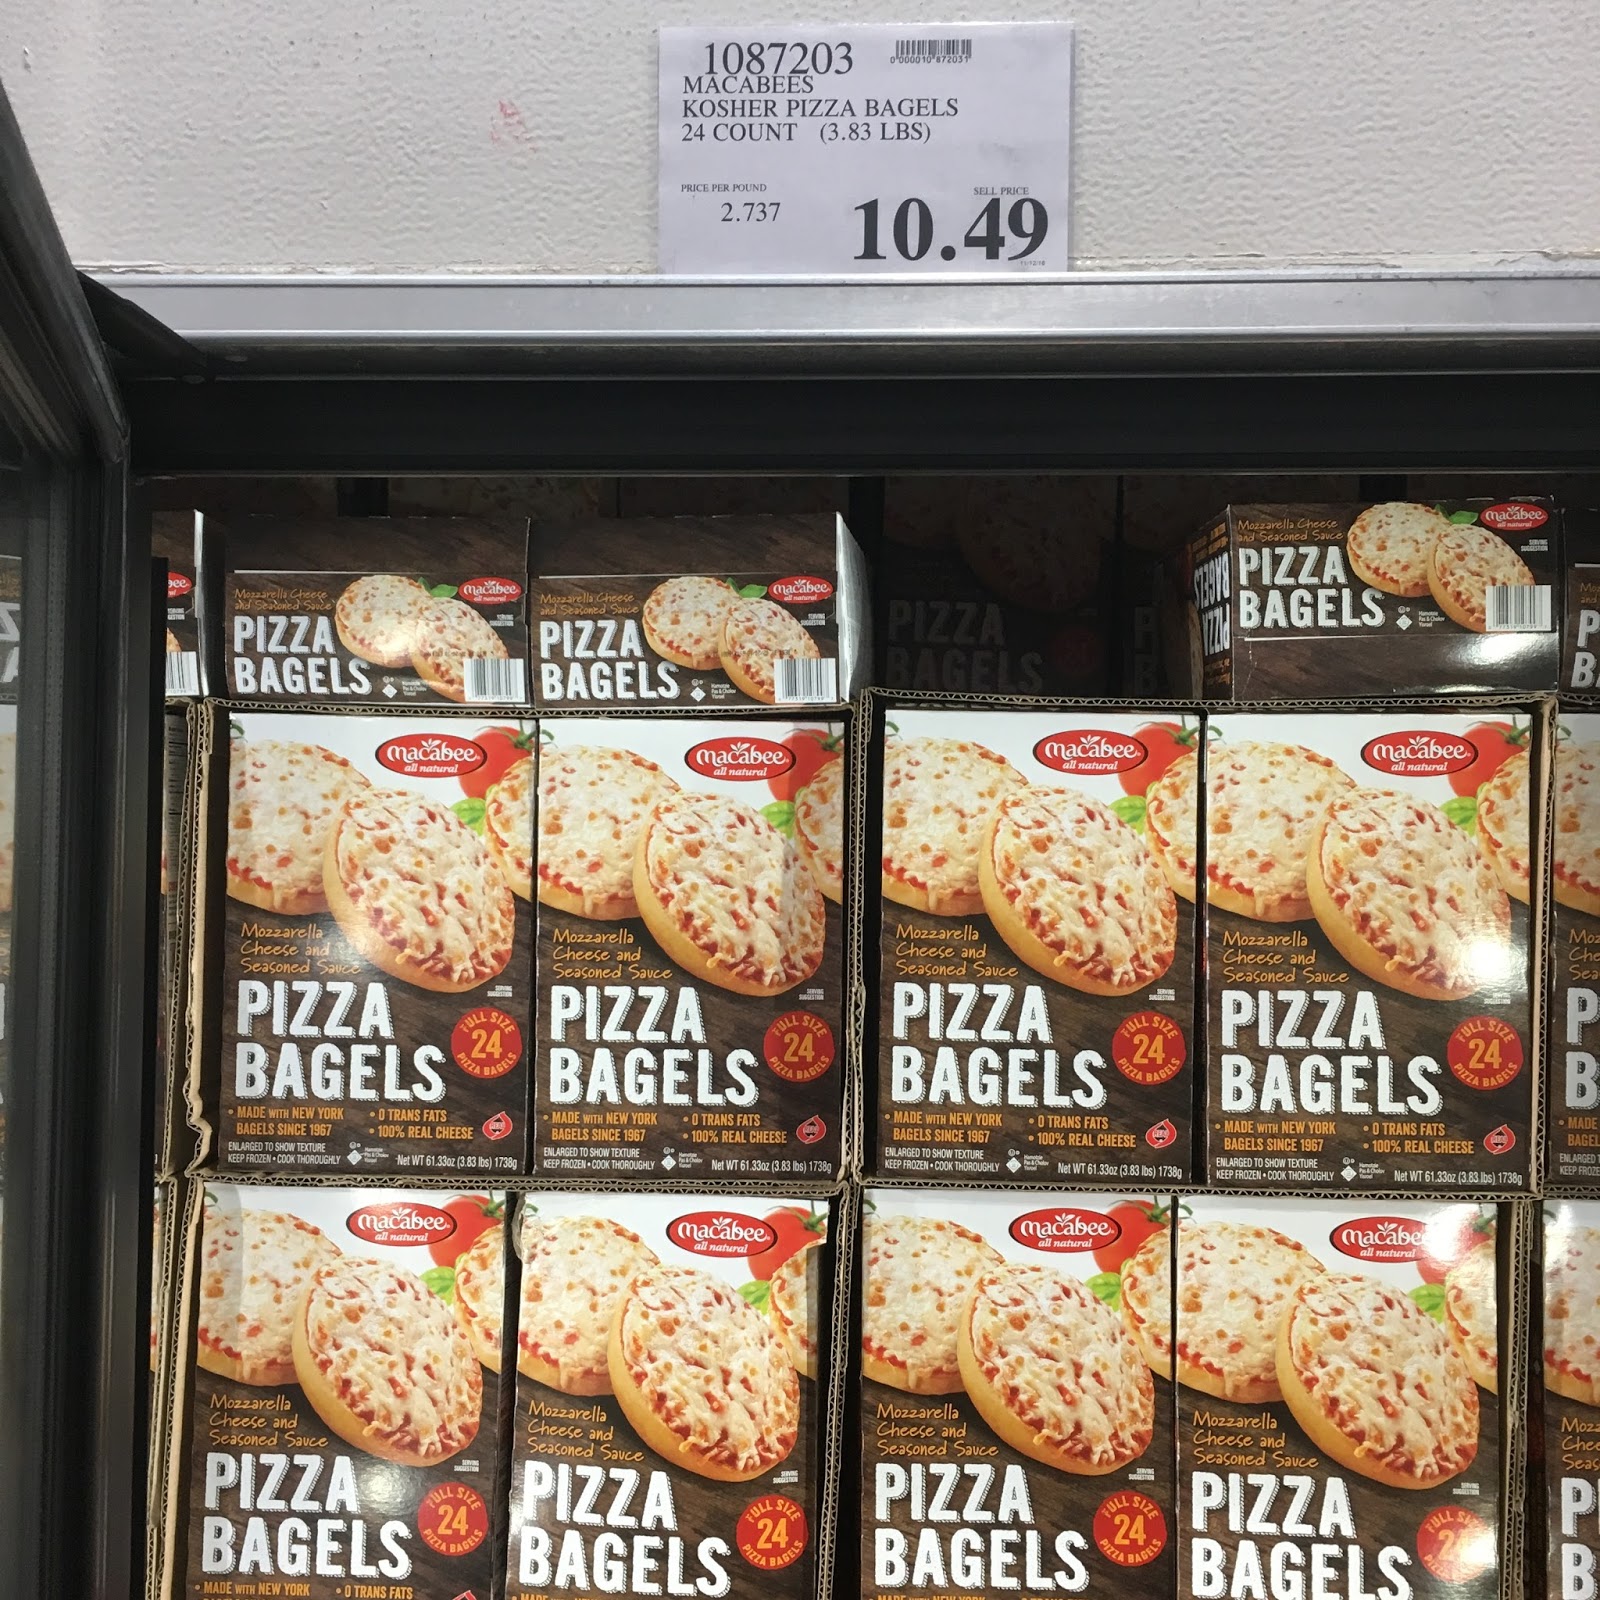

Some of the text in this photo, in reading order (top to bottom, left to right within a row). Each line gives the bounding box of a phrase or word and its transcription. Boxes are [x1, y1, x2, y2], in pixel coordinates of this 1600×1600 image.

[705, 42, 853, 75] 1087203
[683, 75, 814, 94] MACABEES
[682, 99, 959, 118] KOSHER PIZZA BAGELS
[682, 122, 930, 143] 24 COUNT (3.83 LBS)
[681, 184, 766, 192] PRICE PER POUND
[974, 187, 1029, 195] SELL PRICE
[721, 202, 780, 222] 2.737
[854, 197, 1049, 261] 10.49
[1486, 506, 1544, 521] macabee
[1238, 519, 1338, 530] Mozzarella Cheese
[1238, 530, 1343, 542] and Seasoned Sauce
[1239, 546, 1348, 587] PIZZA
[234, 589, 328, 599] Mozzarella Cheese
[464, 581, 519, 596] macabee
[773, 579, 828, 594] macabee
[234, 600, 332, 611] and Seasoned Sauce
[540, 593, 634, 603] Mozzarella Cheese
[540, 604, 640, 615] and Seasoned Sauce
[1240, 588, 1385, 629] BAGELS
[888, 602, 1005, 645] PIZZA
[234, 615, 336, 654] PIZZA
[540, 620, 644, 659] PIZZA
[234, 657, 372, 694] BAGELS
[541, 661, 680, 700] BAGELS
[886, 648, 1043, 694] BAGELS
[387, 739, 479, 763] macabee
[696, 742, 787, 766] macabee
[1045, 735, 1139, 760] macabee
[1372, 736, 1469, 761] macabee
[405, 763, 458, 773] all natural
[714, 766, 767, 776] all natural
[1062, 760, 1118, 770] all natural
[1391, 761, 1448, 771] all natural
[241, 924, 323, 939] Mozzarella
[553, 929, 634, 944] Mozzarella
[896, 924, 979, 940] Mozzarella
[1223, 931, 1308, 947] Mozzarella
[241, 942, 330, 956] Cheese and
[553, 947, 641, 962] Cheese and
[896, 943, 986, 958] Cheese and
[1223, 950, 1316, 965] Cheese and
[241, 960, 361, 974] Seasoned Sauce
[553, 965, 672, 979] Seasoned Sauce
[896, 961, 1018, 977] Seasoned Sauce
[1224, 968, 1349, 984] Seasoned Sauce
[237, 980, 395, 1039] PIZZA
[551, 985, 707, 1044] PIZZA
[893, 982, 1053, 1043] PIZZA
[1221, 989, 1387, 1050] PIZZA
[1121, 1016, 1178, 1039] FULL SIZE
[1456, 1020, 1514, 1044] FULL SIZE
[1133, 1034, 1165, 1065] 24
[1468, 1038, 1502, 1069] 24
[236, 1043, 446, 1103] BAGELS
[550, 1048, 759, 1107] BAGELS
[892, 1046, 1107, 1110] BAGELS
[1118, 1058, 1181, 1082] PIZZA BAGELS
[1453, 1062, 1518, 1087] PIZZA BAGELS
[1221, 1054, 1443, 1116] BAGELS
[894, 1112, 922, 1123] MADE
[949, 1114, 973, 1125] NEW
[976, 1114, 1002, 1126] YORK
[1048, 1117, 1081, 1129] TRANS
[1084, 1118, 1108, 1129] FATS
[893, 1129, 990, 1143] BAGELS SINCE 1967
[1038, 1133, 1136, 1147] 100% REAL CHEESE
[885, 1147, 984, 1160] ENLARGED TO SHOW TEXTURE
[885, 1159, 999, 1172] KEEP FROZEN COOK THOROUGHLY
[1058, 1163, 1182, 1179] Net WT 61.33oz (3.83 lbs) 1738g
[358, 1207, 448, 1232] macabee
[678, 1216, 769, 1242] macabee
[1021, 1213, 1112, 1238] macabee
[375, 1232, 428, 1242] all natural
[1038, 1238, 1092, 1248] all natural
[694, 1241, 748, 1254] all natural
[205, 1452, 360, 1514] PIZZA
[523, 1460, 678, 1531] PIZZA
[875, 1463, 1034, 1524] PIZZA
[1191, 1471, 1356, 1539] PIZZA
[202, 1516, 413, 1580] BAGELS
[519, 1526, 731, 1597] BAGELS
[874, 1528, 1090, 1592] BAGELS
[1191, 1538, 1413, 1600] BAGELS
